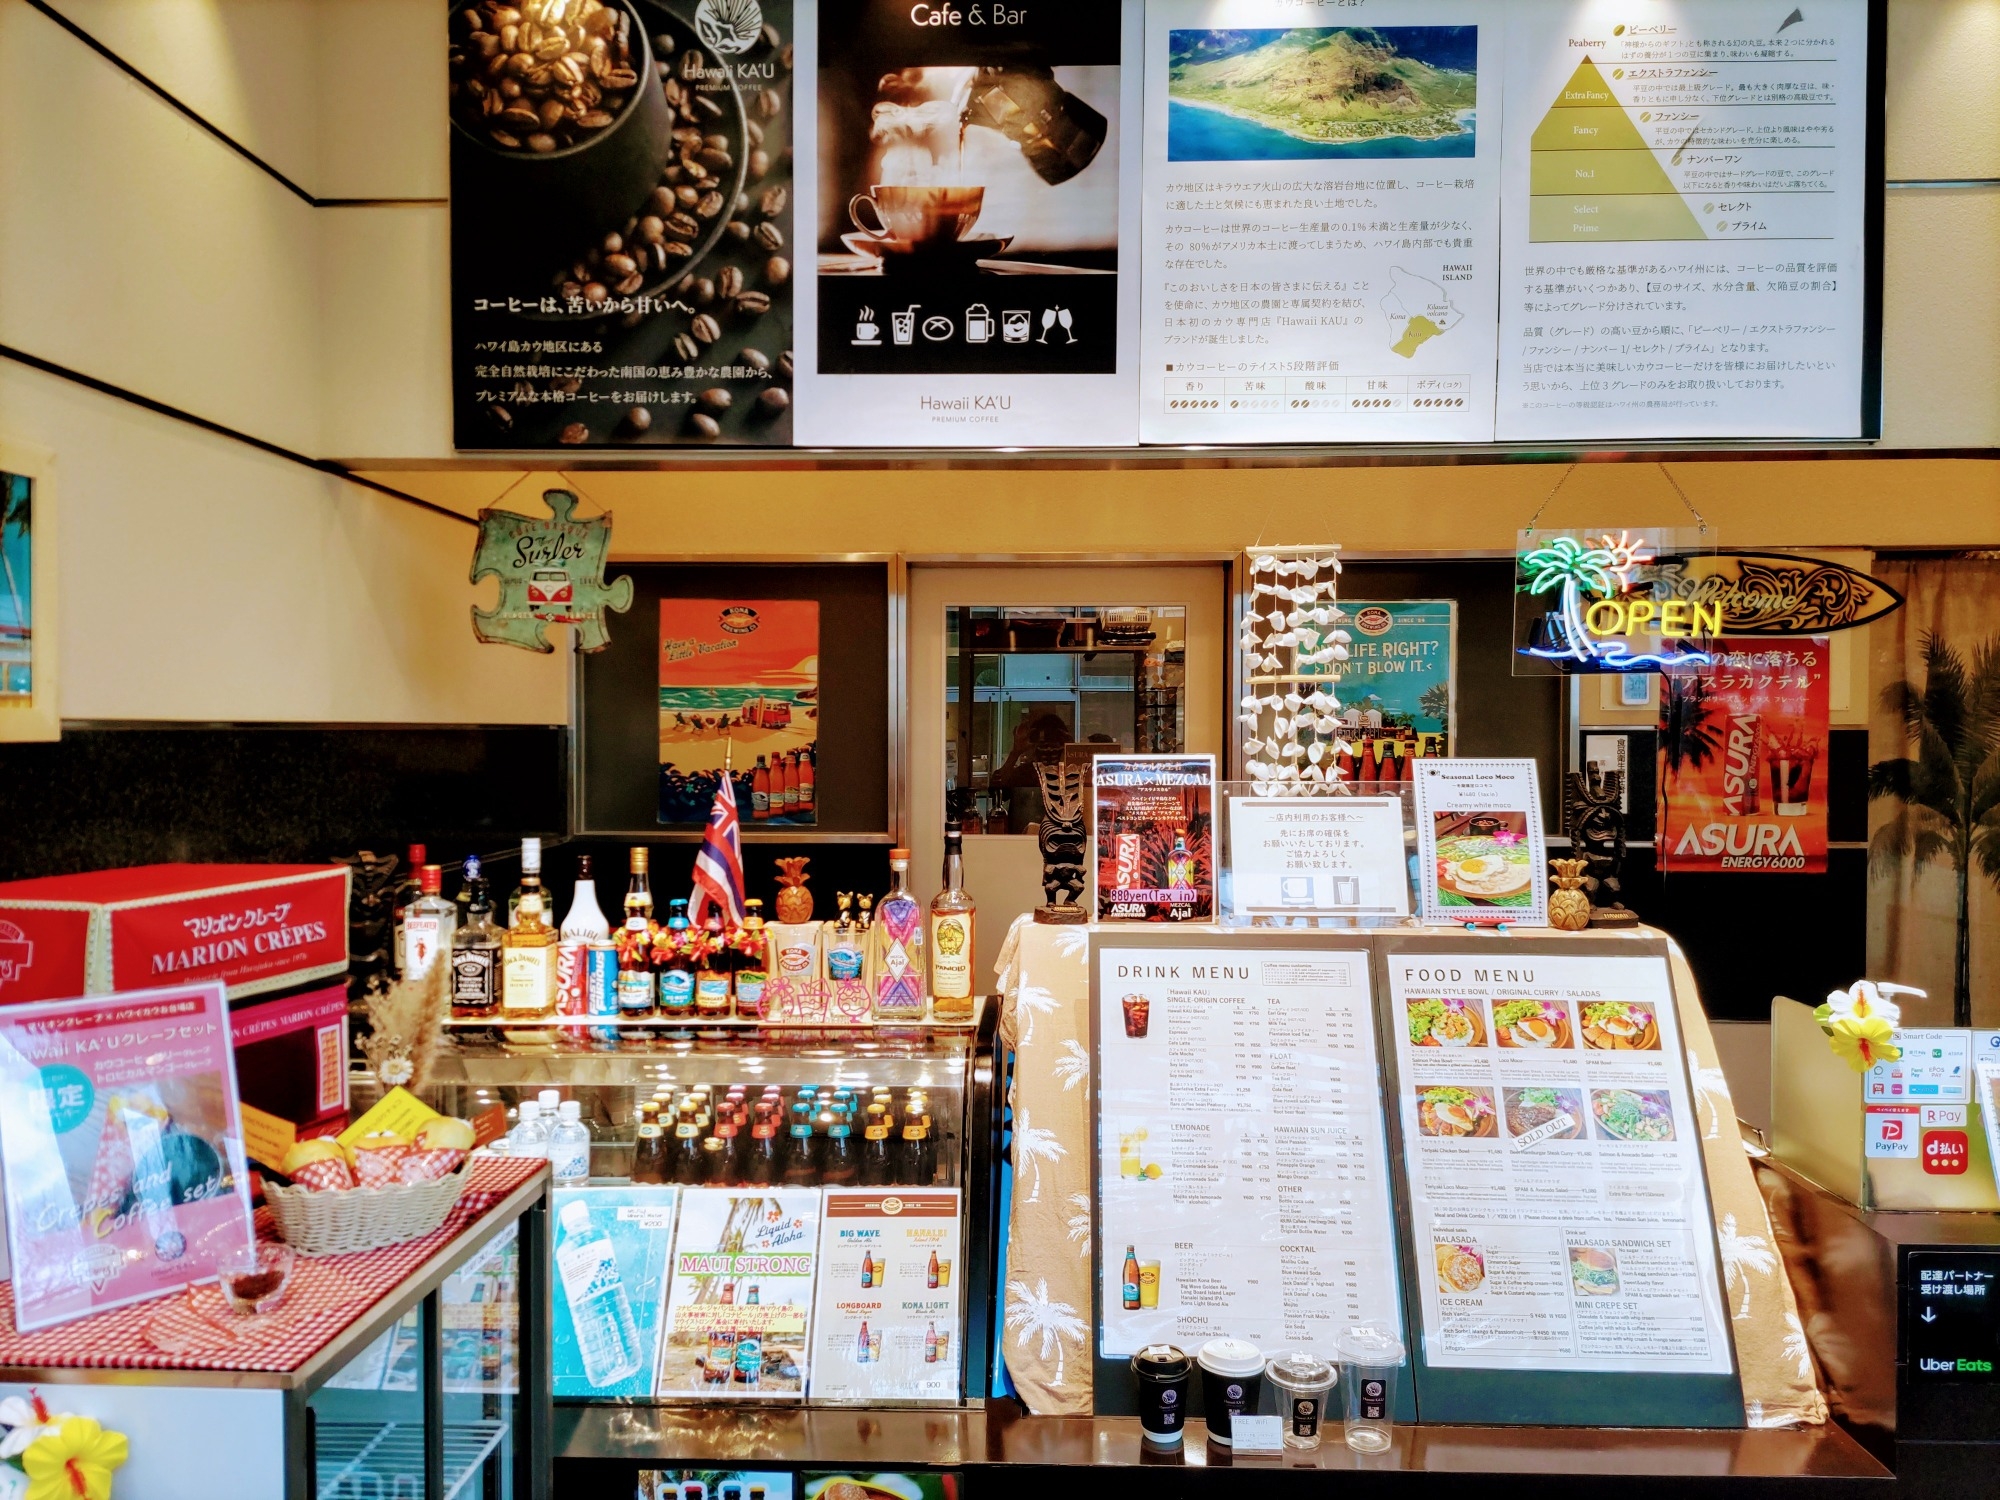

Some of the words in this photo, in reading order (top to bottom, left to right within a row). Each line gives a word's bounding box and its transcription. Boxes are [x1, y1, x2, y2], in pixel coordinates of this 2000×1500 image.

[911, 4, 962, 26] Cafe
[969, 5, 989, 25] &
[994, 5, 1027, 25] Bar
[1629, 25, 1677, 34] ピーベリー
[1568, 38, 1606, 49] Peaberry
[683, 63, 734, 79] Hawaii
[1628, 68, 1718, 78] エクストラファンシー
[1565, 91, 1585, 100] Extra
[1585, 91, 1609, 101] Fancy
[1655, 111, 1699, 122] ファンシー
[1573, 125, 1599, 136] Fancy
[1686, 153, 1742, 164] ナンバーワン
[1575, 169, 1594, 178] No.1
[1165, 198, 1379, 211] に適した土と気候にも恵まれた良い土地でした。
[1573, 204, 1598, 214] Select
[1718, 202, 1752, 212] セレクト
[1572, 223, 1599, 232] Prime
[1732, 221, 1767, 231] プライム
[1164, 258, 1229, 269] な存在でした。
[474, 297, 696, 314] コーヒーは、苦いから甘いへ。
[1164, 298, 1367, 311] を使命に、カウ地区の農園と専属契約を結び、
[1523, 301, 1688, 313] 等によってグレード分けされています。
[1749, 324, 1836, 335] エクストラファンシー
[1164, 334, 1270, 345] ブランドが誕生しました。
[475, 340, 603, 353] ハワイ島カウ地区にある
[1529, 345, 1572, 354] ファンシー
[1633, 343, 1665, 354] セレクト
[474, 365, 773, 378] 完全自然栽培にこだわった南国の恵み豊かな農園から、
[1175, 361, 1339, 373] カウコーヒーのテイスト5段階評価
[1185, 381, 1204, 391] 香り
[1244, 381, 1266, 391] 苦味
[1305, 381, 1327, 391] 酸味
[1367, 380, 1388, 390] 甘味
[475, 390, 697, 404] プレミアムな本格コーヒーをお届けします。
[920, 395, 969, 411] Hawaii
[973, 395, 1011, 410] KA'U
[512, 532, 585, 568] Surfer
[1677, 577, 1801, 621] Welcome
[1586, 599, 1723, 638] OPEN
[664, 640, 686, 650] Have
[668, 650, 693, 661] Little
[698, 640, 737, 654] Vacation
[1382, 641, 1439, 658] RIGHT?
[1324, 662, 1363, 674] DON'T
[1368, 660, 1405, 674] BLOW
[1280, 829, 1350, 838] 先にお席の確保を
[1262, 839, 1366, 848] お願いいたしております。
[1674, 823, 1806, 857] ASURA
[1286, 850, 1346, 858] ご協力よろしく
[1286, 860, 1354, 869] お願い致します。
[1721, 856, 1806, 869] ENERGY6000
[1179, 890, 1195, 902] in)
[1111, 904, 1146, 913] ASURA
[1170, 908, 1192, 920] Ajal
[183, 902, 292, 939] マリオンクレープ
[407, 921, 437, 931] BEEFEATER
[151, 936, 249, 974] MARION
[254, 920, 327, 954] CRÊPES
[891, 958, 905, 966] Ajal
[935, 964, 966, 972] PANIOLO
[1118, 965, 1181, 979] DRINK
[1192, 966, 1250, 979] MENU
[1404, 969, 1462, 982] FOOD
[1475, 969, 1536, 982] MENU
[280, 1011, 313, 1025] MARION
[1939, 1110, 1961, 1123] Pay
[1274, 1126, 1309, 1134] HAWAIIAN
[1517, 1127, 1545, 1148] SOLD
[1547, 1117, 1569, 1135] OUT
[1875, 1142, 1908, 1152] PayPay
[1926, 1140, 1963, 1155] d払い
[182, 1175, 218, 1202] set
[35, 1186, 124, 1233] Crepes
[131, 1160, 173, 1196] and
[755, 1219, 791, 1239] Liquid
[906, 1229, 948, 1237] HANALEI
[771, 1230, 803, 1248] Aloha
[1174, 1242, 1194, 1250] BEER
[1280, 1245, 1316, 1253] COCKTAIL
[680, 1256, 730, 1274] MAUI
[734, 1256, 810, 1274] STRONG
[1920, 1270, 1994, 1281] 配達パートナー
[1920, 1284, 1985, 1295] 受け渡し場所
[1440, 1298, 1452, 1306] ICE
[1575, 1301, 1594, 1309] MINI
[1176, 1316, 1209, 1324] SHOCHU
[1920, 1358, 1954, 1371] Uber
[1957, 1358, 1992, 1371] Eats
